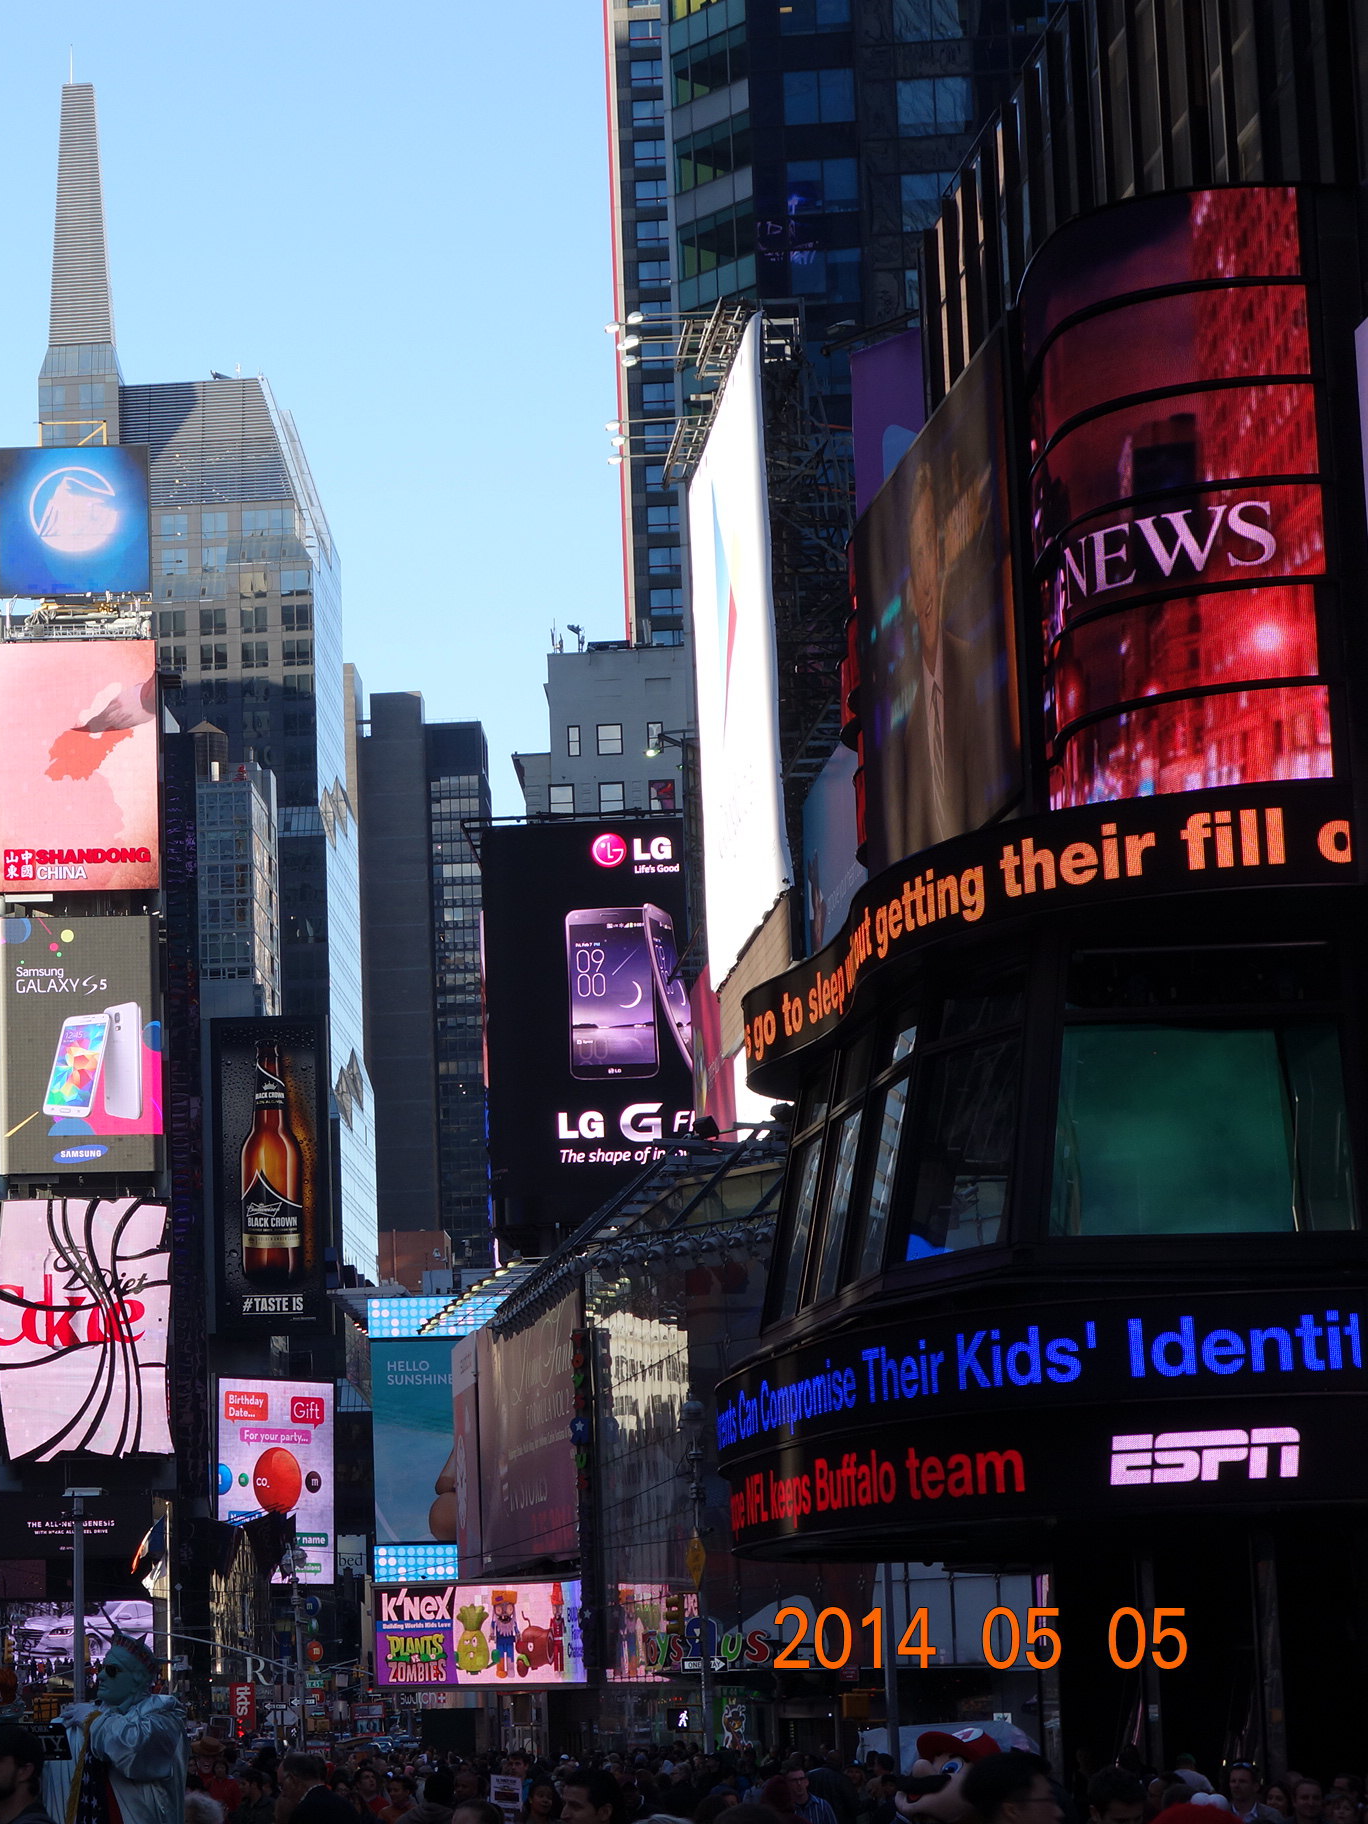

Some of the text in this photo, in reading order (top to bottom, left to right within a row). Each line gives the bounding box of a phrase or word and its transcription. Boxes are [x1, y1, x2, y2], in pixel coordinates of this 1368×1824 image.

[35, 847, 152, 865] SHANDONG
[633, 836, 672, 861] LG
[1000, 822, 1156, 898] their
[1180, 807, 1286, 871] fill
[36, 866, 87, 880] CHINA
[634, 863, 680, 874] Life's Good
[576, 949, 605, 974] 09
[753, 1009, 776, 1062] go
[781, 991, 803, 1037] to
[808, 971, 845, 1016] sleep
[875, 865, 986, 959] getting
[16, 966, 64, 978] Samsung
[16, 978, 80, 994] GALAXY
[577, 973, 606, 998] 00
[557, 1103, 663, 1142] LG G
[60, 1150, 102, 1158] SAMSUNG
[560, 1147, 651, 1165] The shape of
[248, 1216, 298, 1228] BLACK CROWN
[243, 1297, 304, 1312] #TASTE IS
[387, 1361, 430, 1371] HELLO
[387, 1374, 453, 1385] SUNSHINE
[738, 1389, 759, 1440] Can
[760, 1358, 857, 1435] Compromise
[861, 1339, 944, 1403] Their
[956, 1321, 1097, 1390] Kids'
[228, 1394, 264, 1409] Birthday
[293, 1401, 320, 1420] Gift
[228, 1407, 256, 1418] Date...
[244, 1430, 309, 1443] For your party...
[1110, 1427, 1301, 1485] ESPN
[745, 1447, 1026, 1529] NFL keeps Buffalo team
[302, 1536, 326, 1545] name
[338, 1553, 363, 1566] bed
[386, 1634, 445, 1656] PLANTS
[388, 1660, 446, 1682] ZOMBIES
[236, 1685, 251, 1717] tkts
